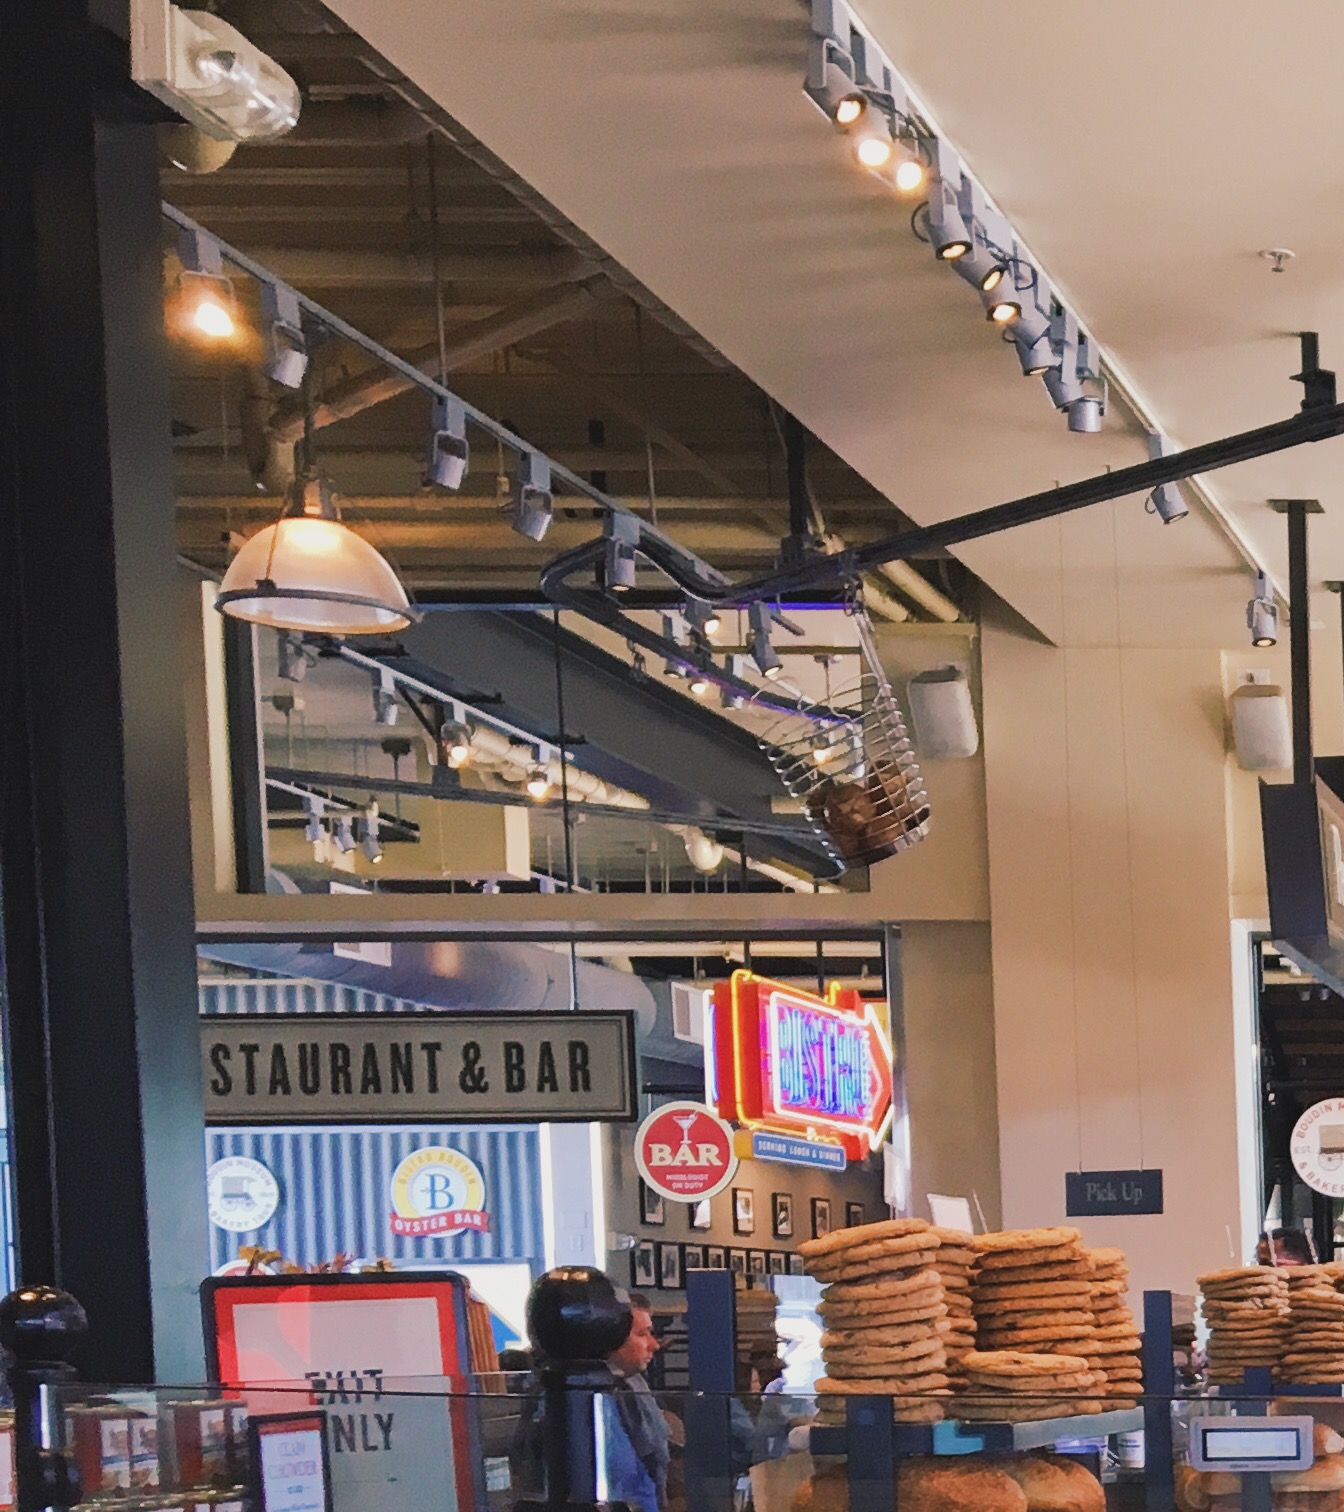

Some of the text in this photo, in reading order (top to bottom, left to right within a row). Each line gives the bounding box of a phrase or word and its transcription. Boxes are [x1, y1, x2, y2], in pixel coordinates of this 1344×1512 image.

[209, 1040, 592, 1096] STAURANT & BAR
[1295, 1103, 1333, 1140] BOUDIN
[648, 1142, 724, 1167] BAR
[1085, 1180, 1143, 1206] Pick Up
[394, 1212, 482, 1233] OYSTER BAR
[304, 1368, 383, 1406] EXIT
[330, 1412, 395, 1453] NLY
